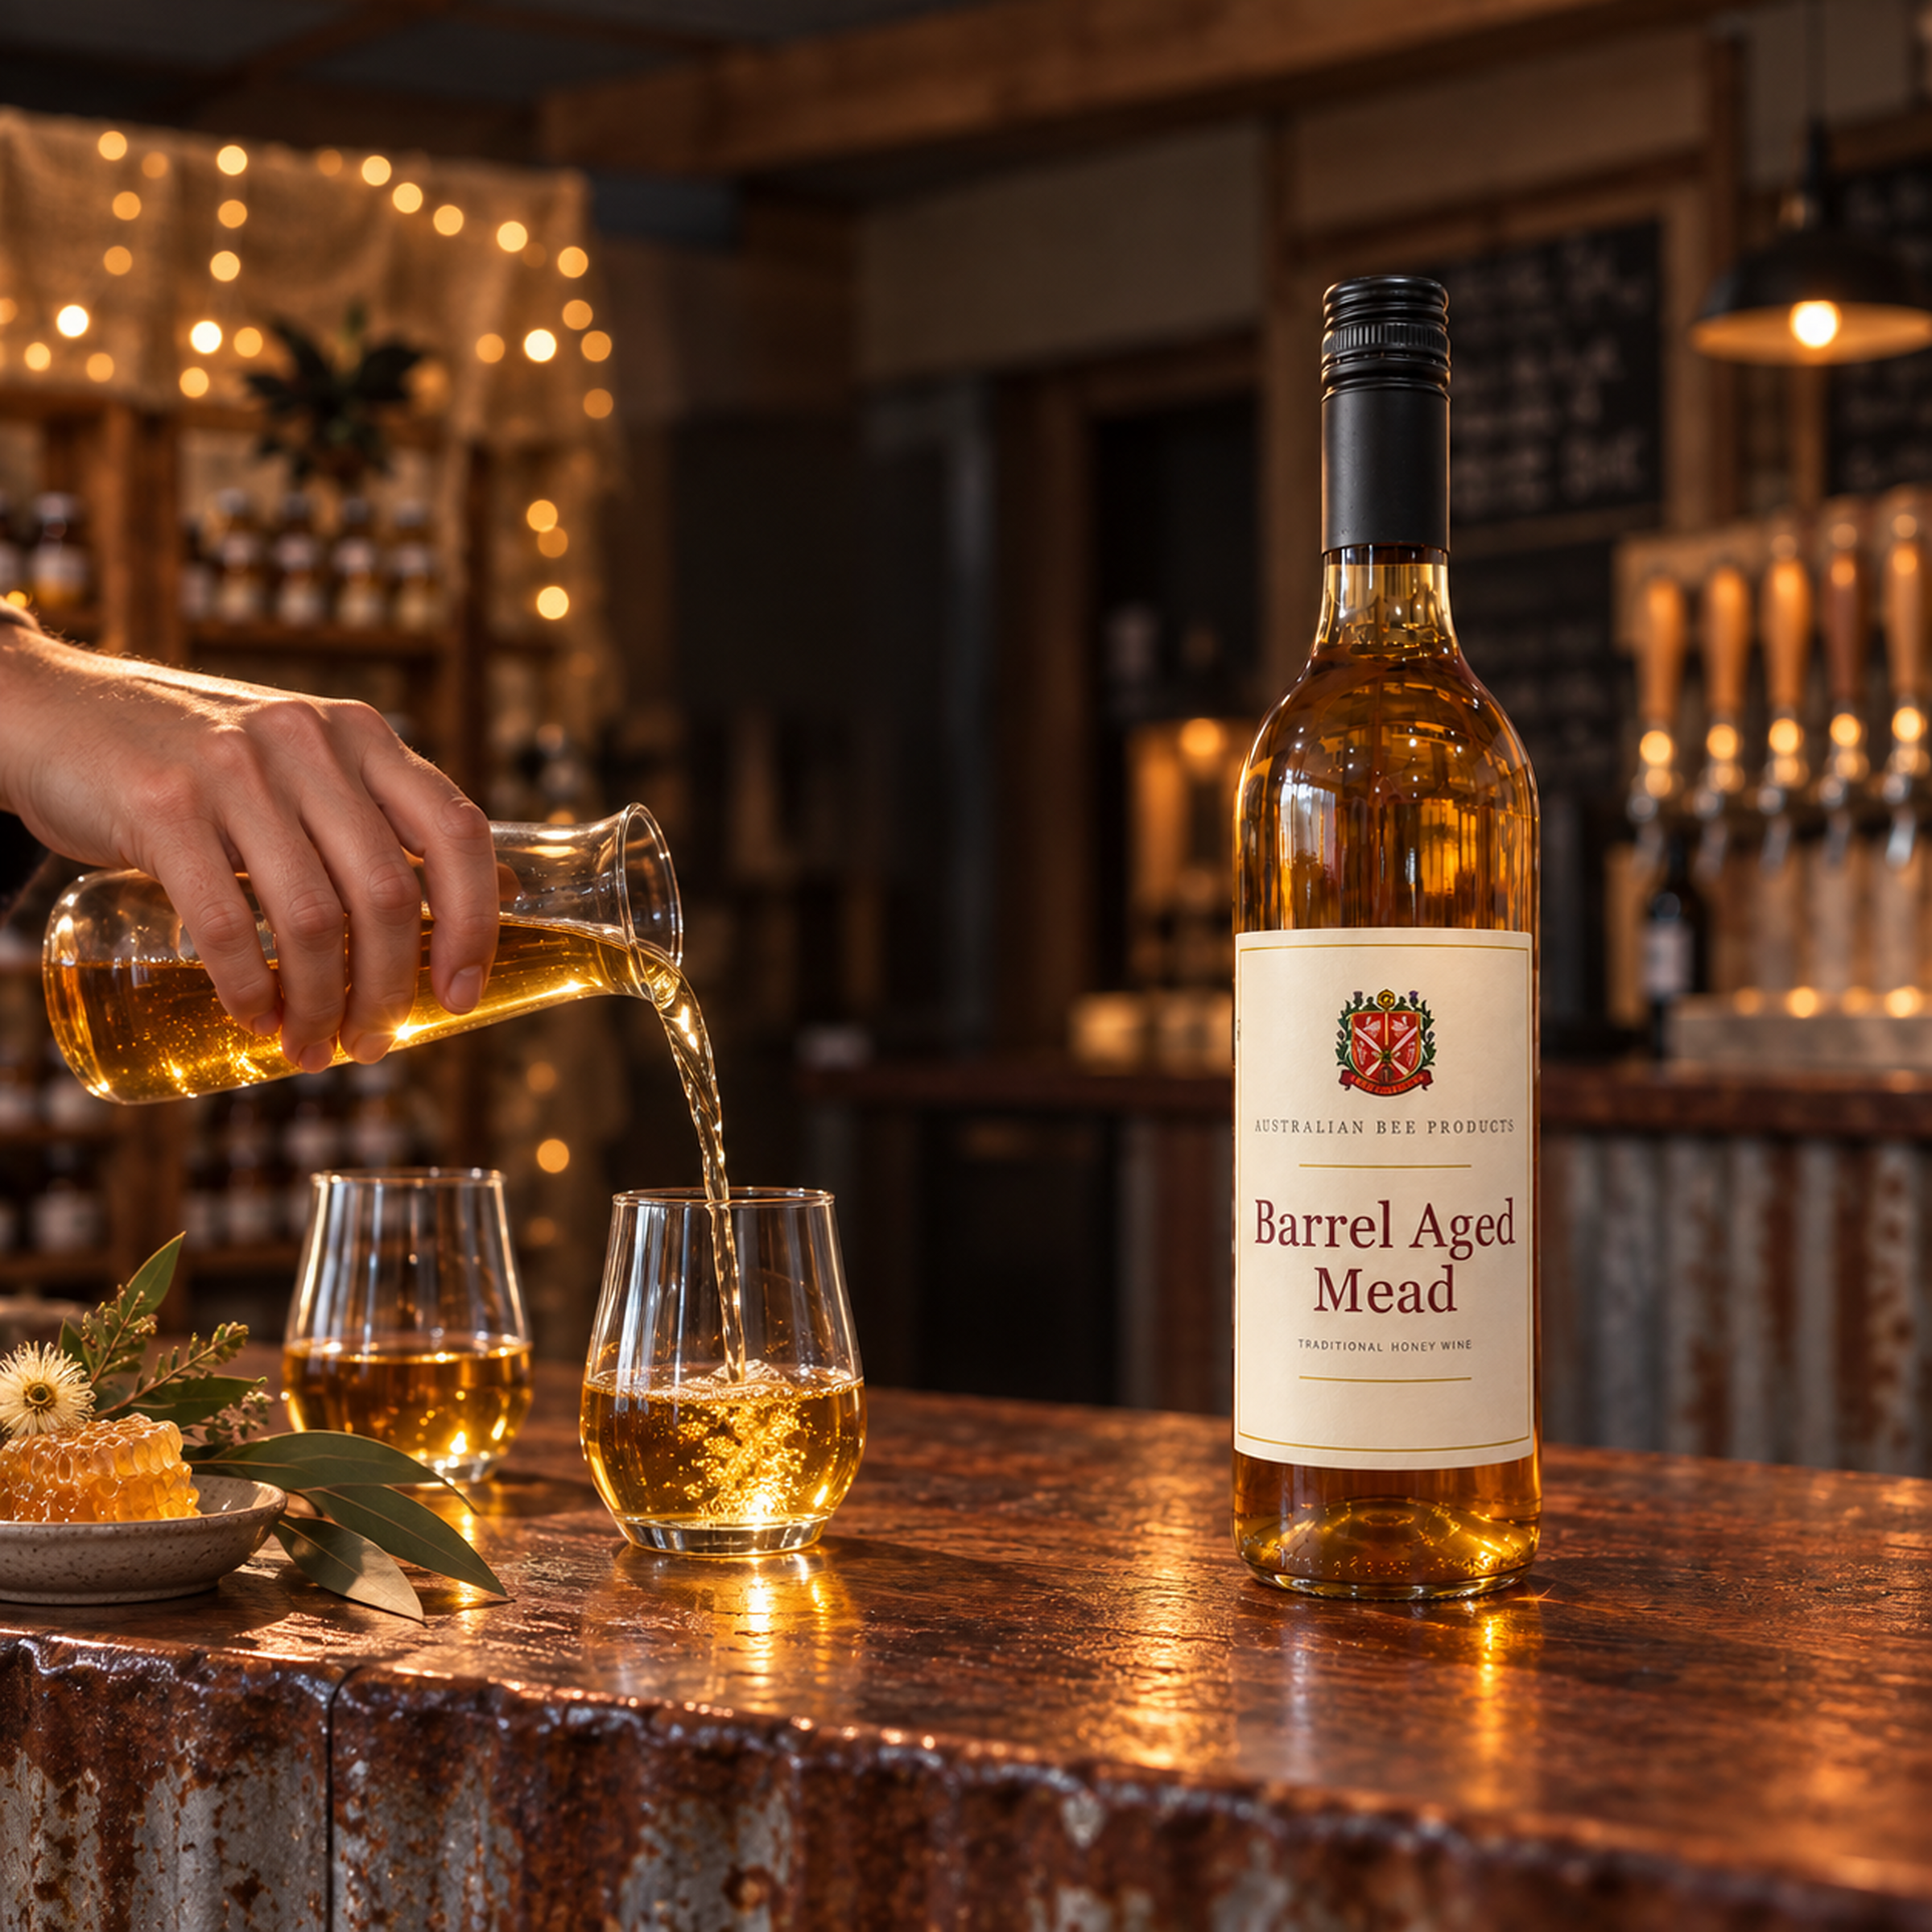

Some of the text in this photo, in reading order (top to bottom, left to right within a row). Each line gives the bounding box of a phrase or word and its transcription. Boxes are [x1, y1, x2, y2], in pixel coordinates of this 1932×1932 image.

[1255, 1119, 1513, 1134] AUSTRALIAN BEE PRODUCTS
[1255, 1197, 1515, 1261] Barrel Aged
[1314, 1265, 1457, 1314] Mead
[1298, 1339, 1472, 1352] TRADITIONAL HONEY WINE
